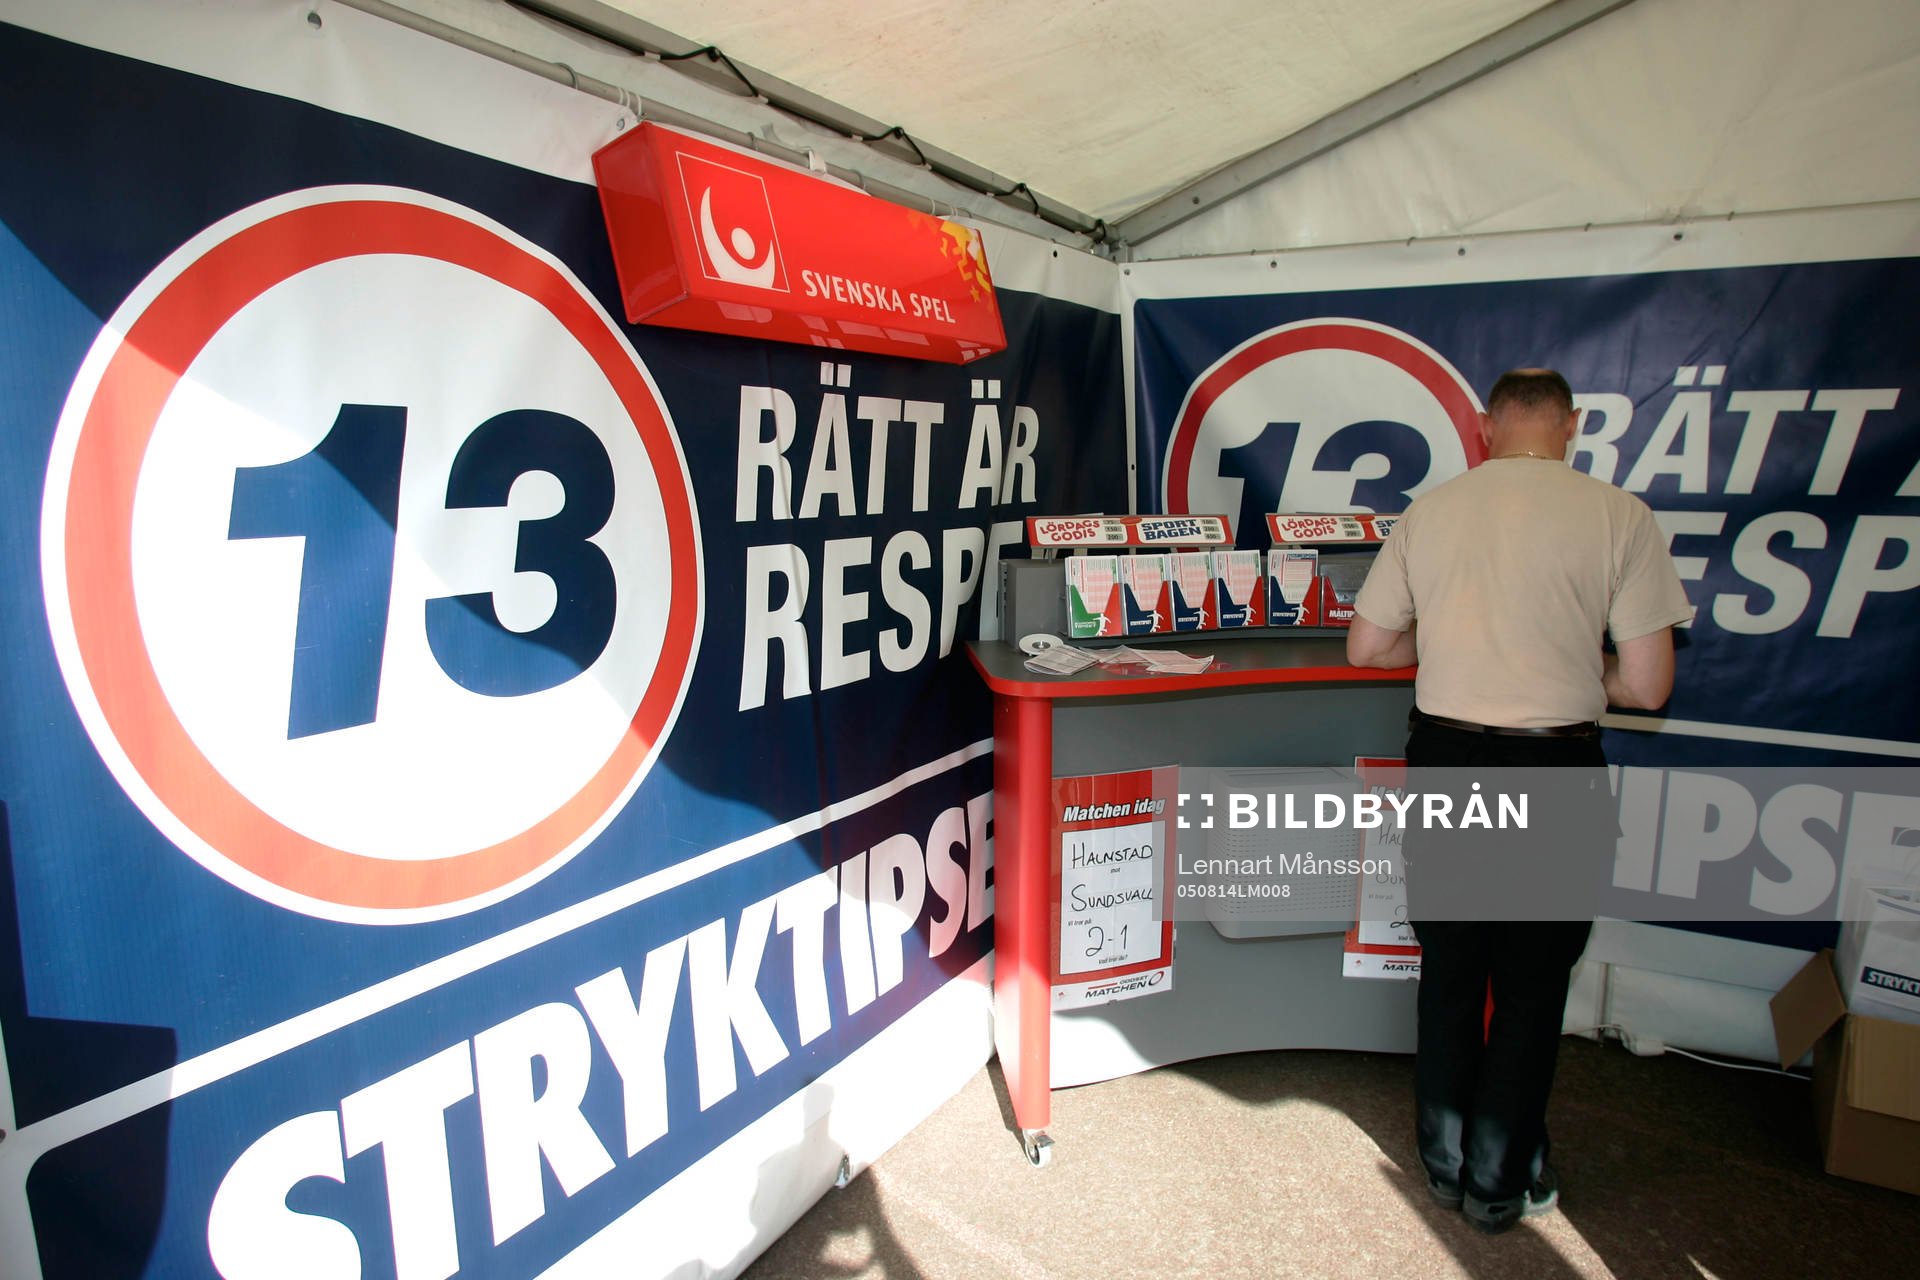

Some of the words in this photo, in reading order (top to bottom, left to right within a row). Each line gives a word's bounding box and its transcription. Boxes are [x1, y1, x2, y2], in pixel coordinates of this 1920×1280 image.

[801, 269, 907, 314] SVENSKA
[909, 292, 957, 324] SPEL
[735, 361, 945, 523] RÄTT
[958, 379, 1040, 509] ÄR
[1564, 365, 1901, 496] RÄTT
[1217, 420, 1432, 553] 13
[1040, 519, 1100, 534] LÖRDAGS
[1051, 528, 1096, 542] GODIS
[1141, 519, 1197, 531] SPORT
[1144, 527, 1202, 541] BAGEN
[1281, 517, 1338, 531] LÖRDAGS
[1293, 525, 1335, 539] GODIS
[227, 403, 617, 741] 13
[738, 512, 1103, 712] RESPE
[1063, 803, 1131, 822] Matchen
[1133, 797, 1166, 815] idag
[1608, 764, 1920, 922] IPSE
[1071, 883, 1154, 912] SUNDSVALL
[1085, 981, 1148, 999] MATCHEN
